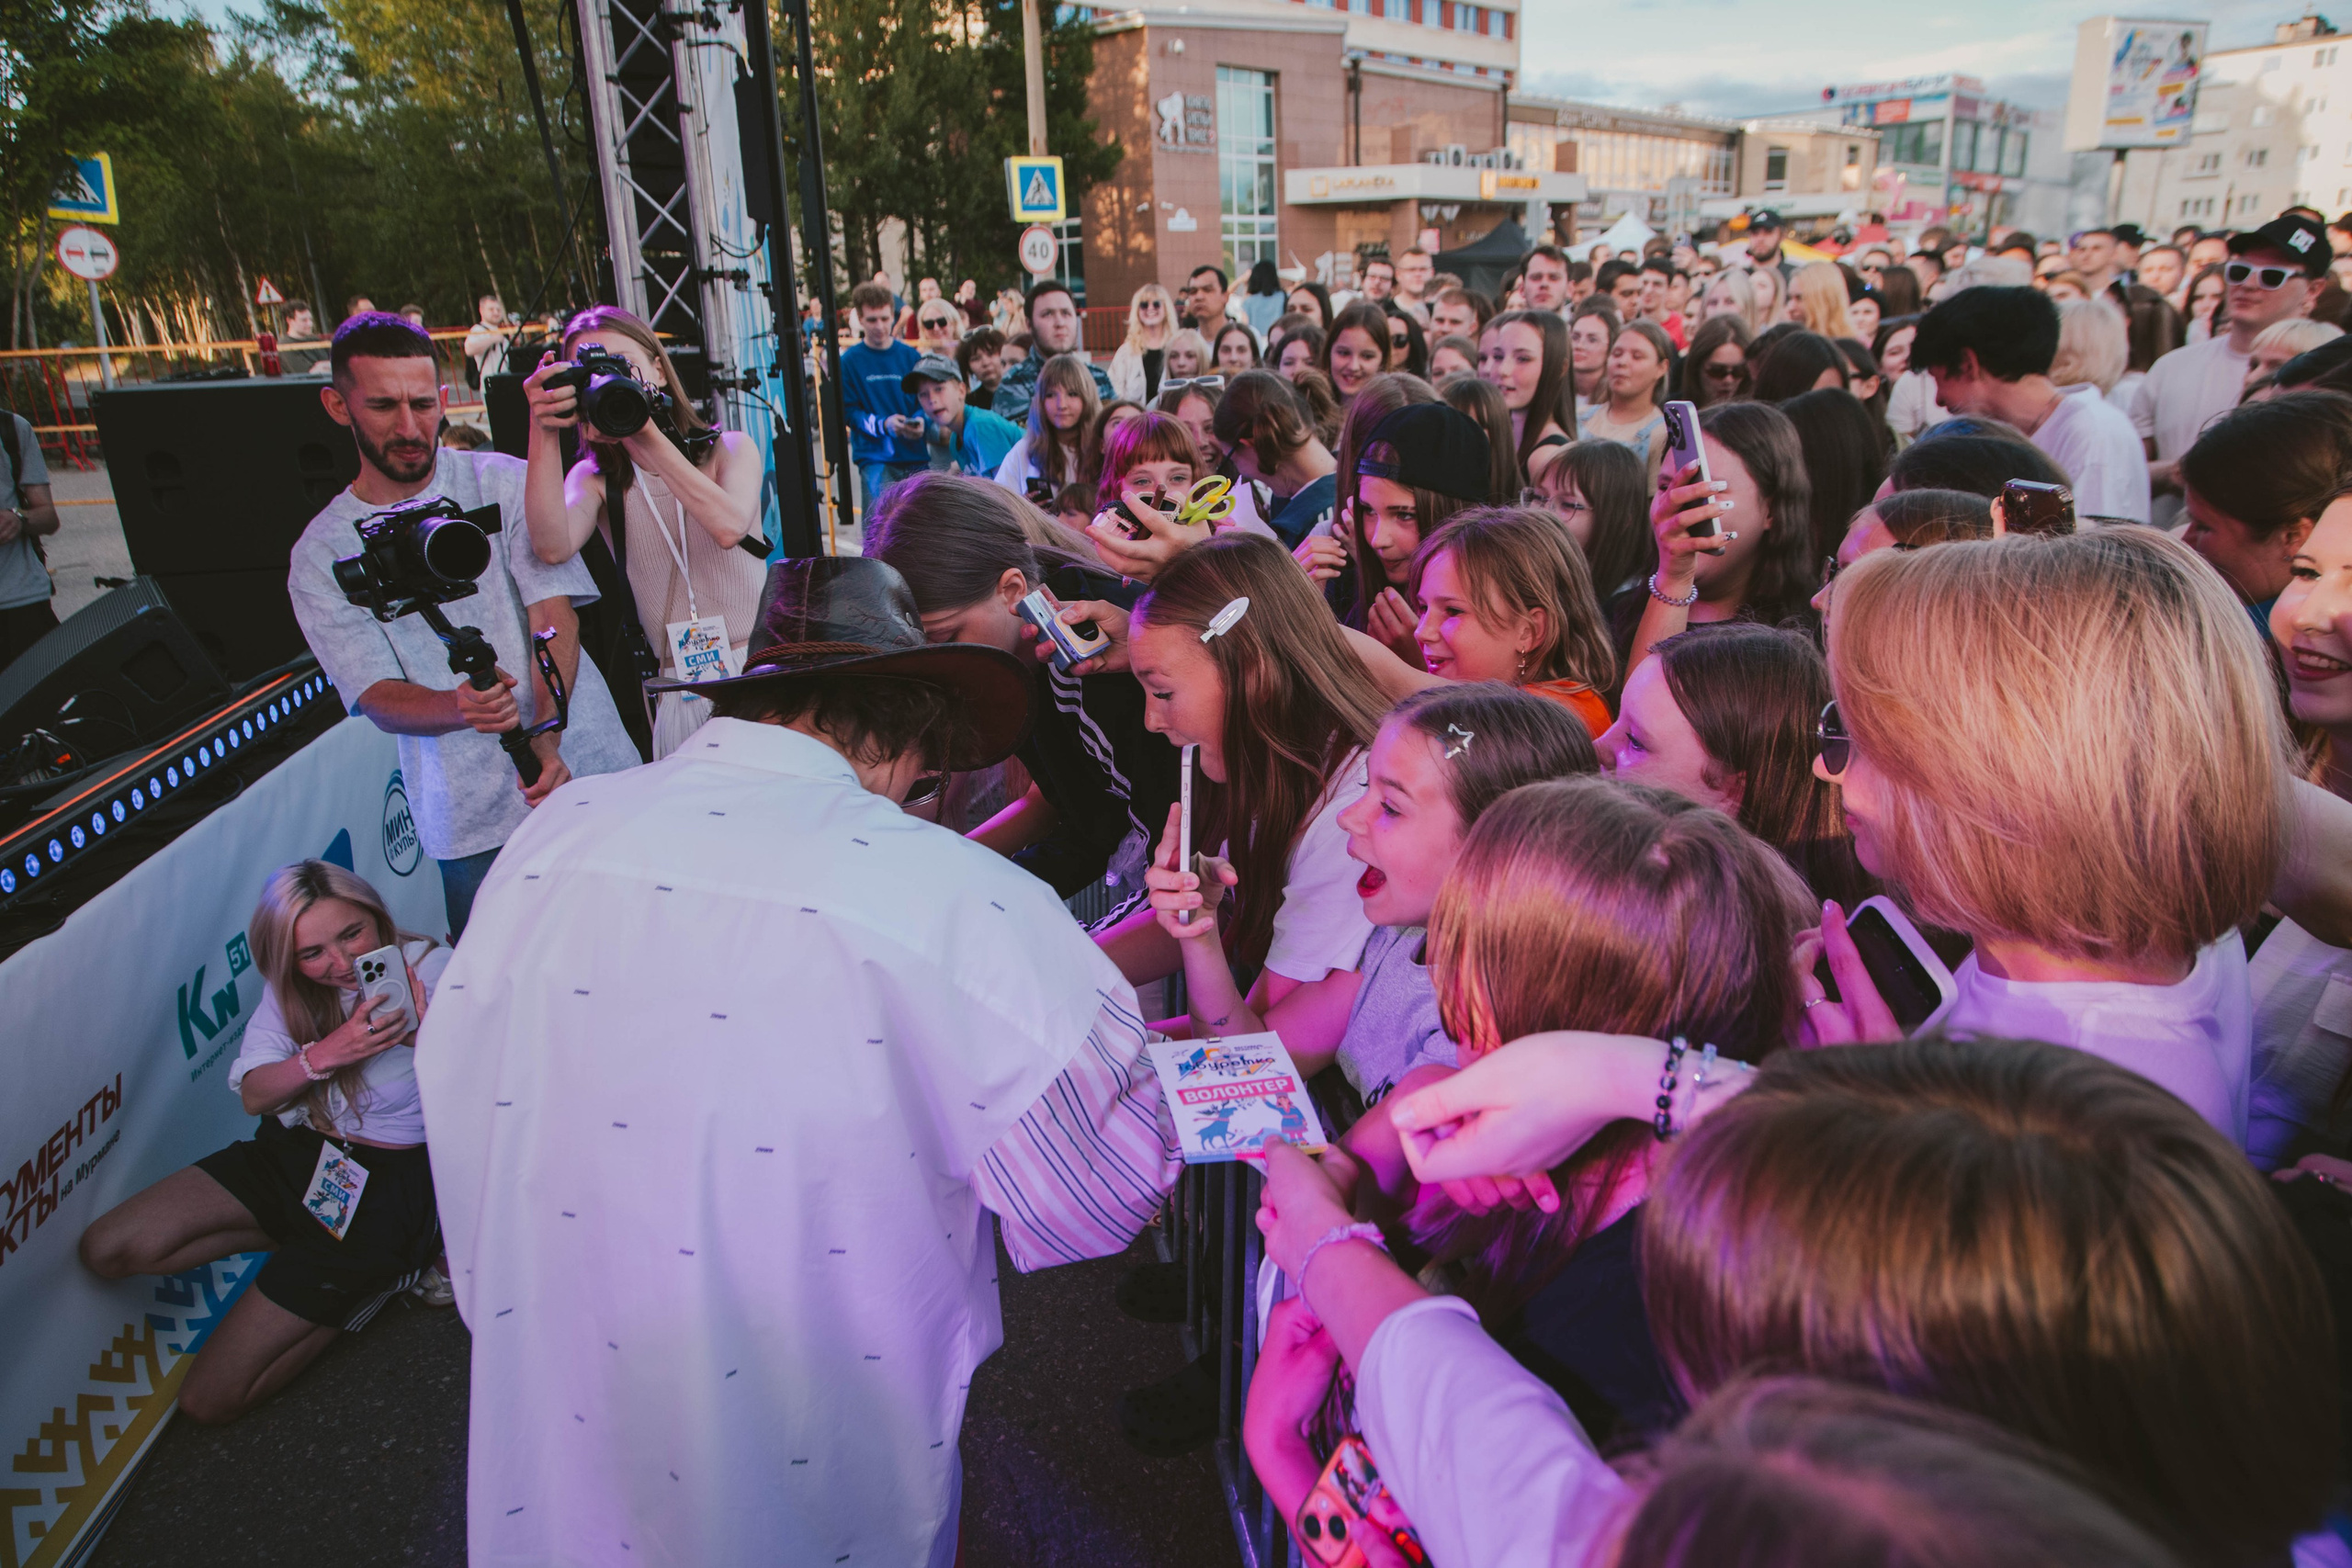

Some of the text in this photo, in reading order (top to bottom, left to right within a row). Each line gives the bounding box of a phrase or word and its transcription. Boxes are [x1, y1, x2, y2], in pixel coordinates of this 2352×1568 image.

[1028, 242, 1049, 259] 40
[688, 651, 716, 666] СМИ
[386, 806, 414, 847] МИН
[393, 829, 417, 857] КУЛЬТ
[229, 940, 249, 970] 51
[190, 1020, 247, 1083] Интернет-изда
[1183, 1078, 1289, 1103] ВОЛОНТЕР
[0, 1072, 122, 1220] УМЕНТЫ
[61, 1179, 73, 1201] на
[75, 1129, 120, 1185] Мурмане
[324, 1181, 345, 1201] СМИ
